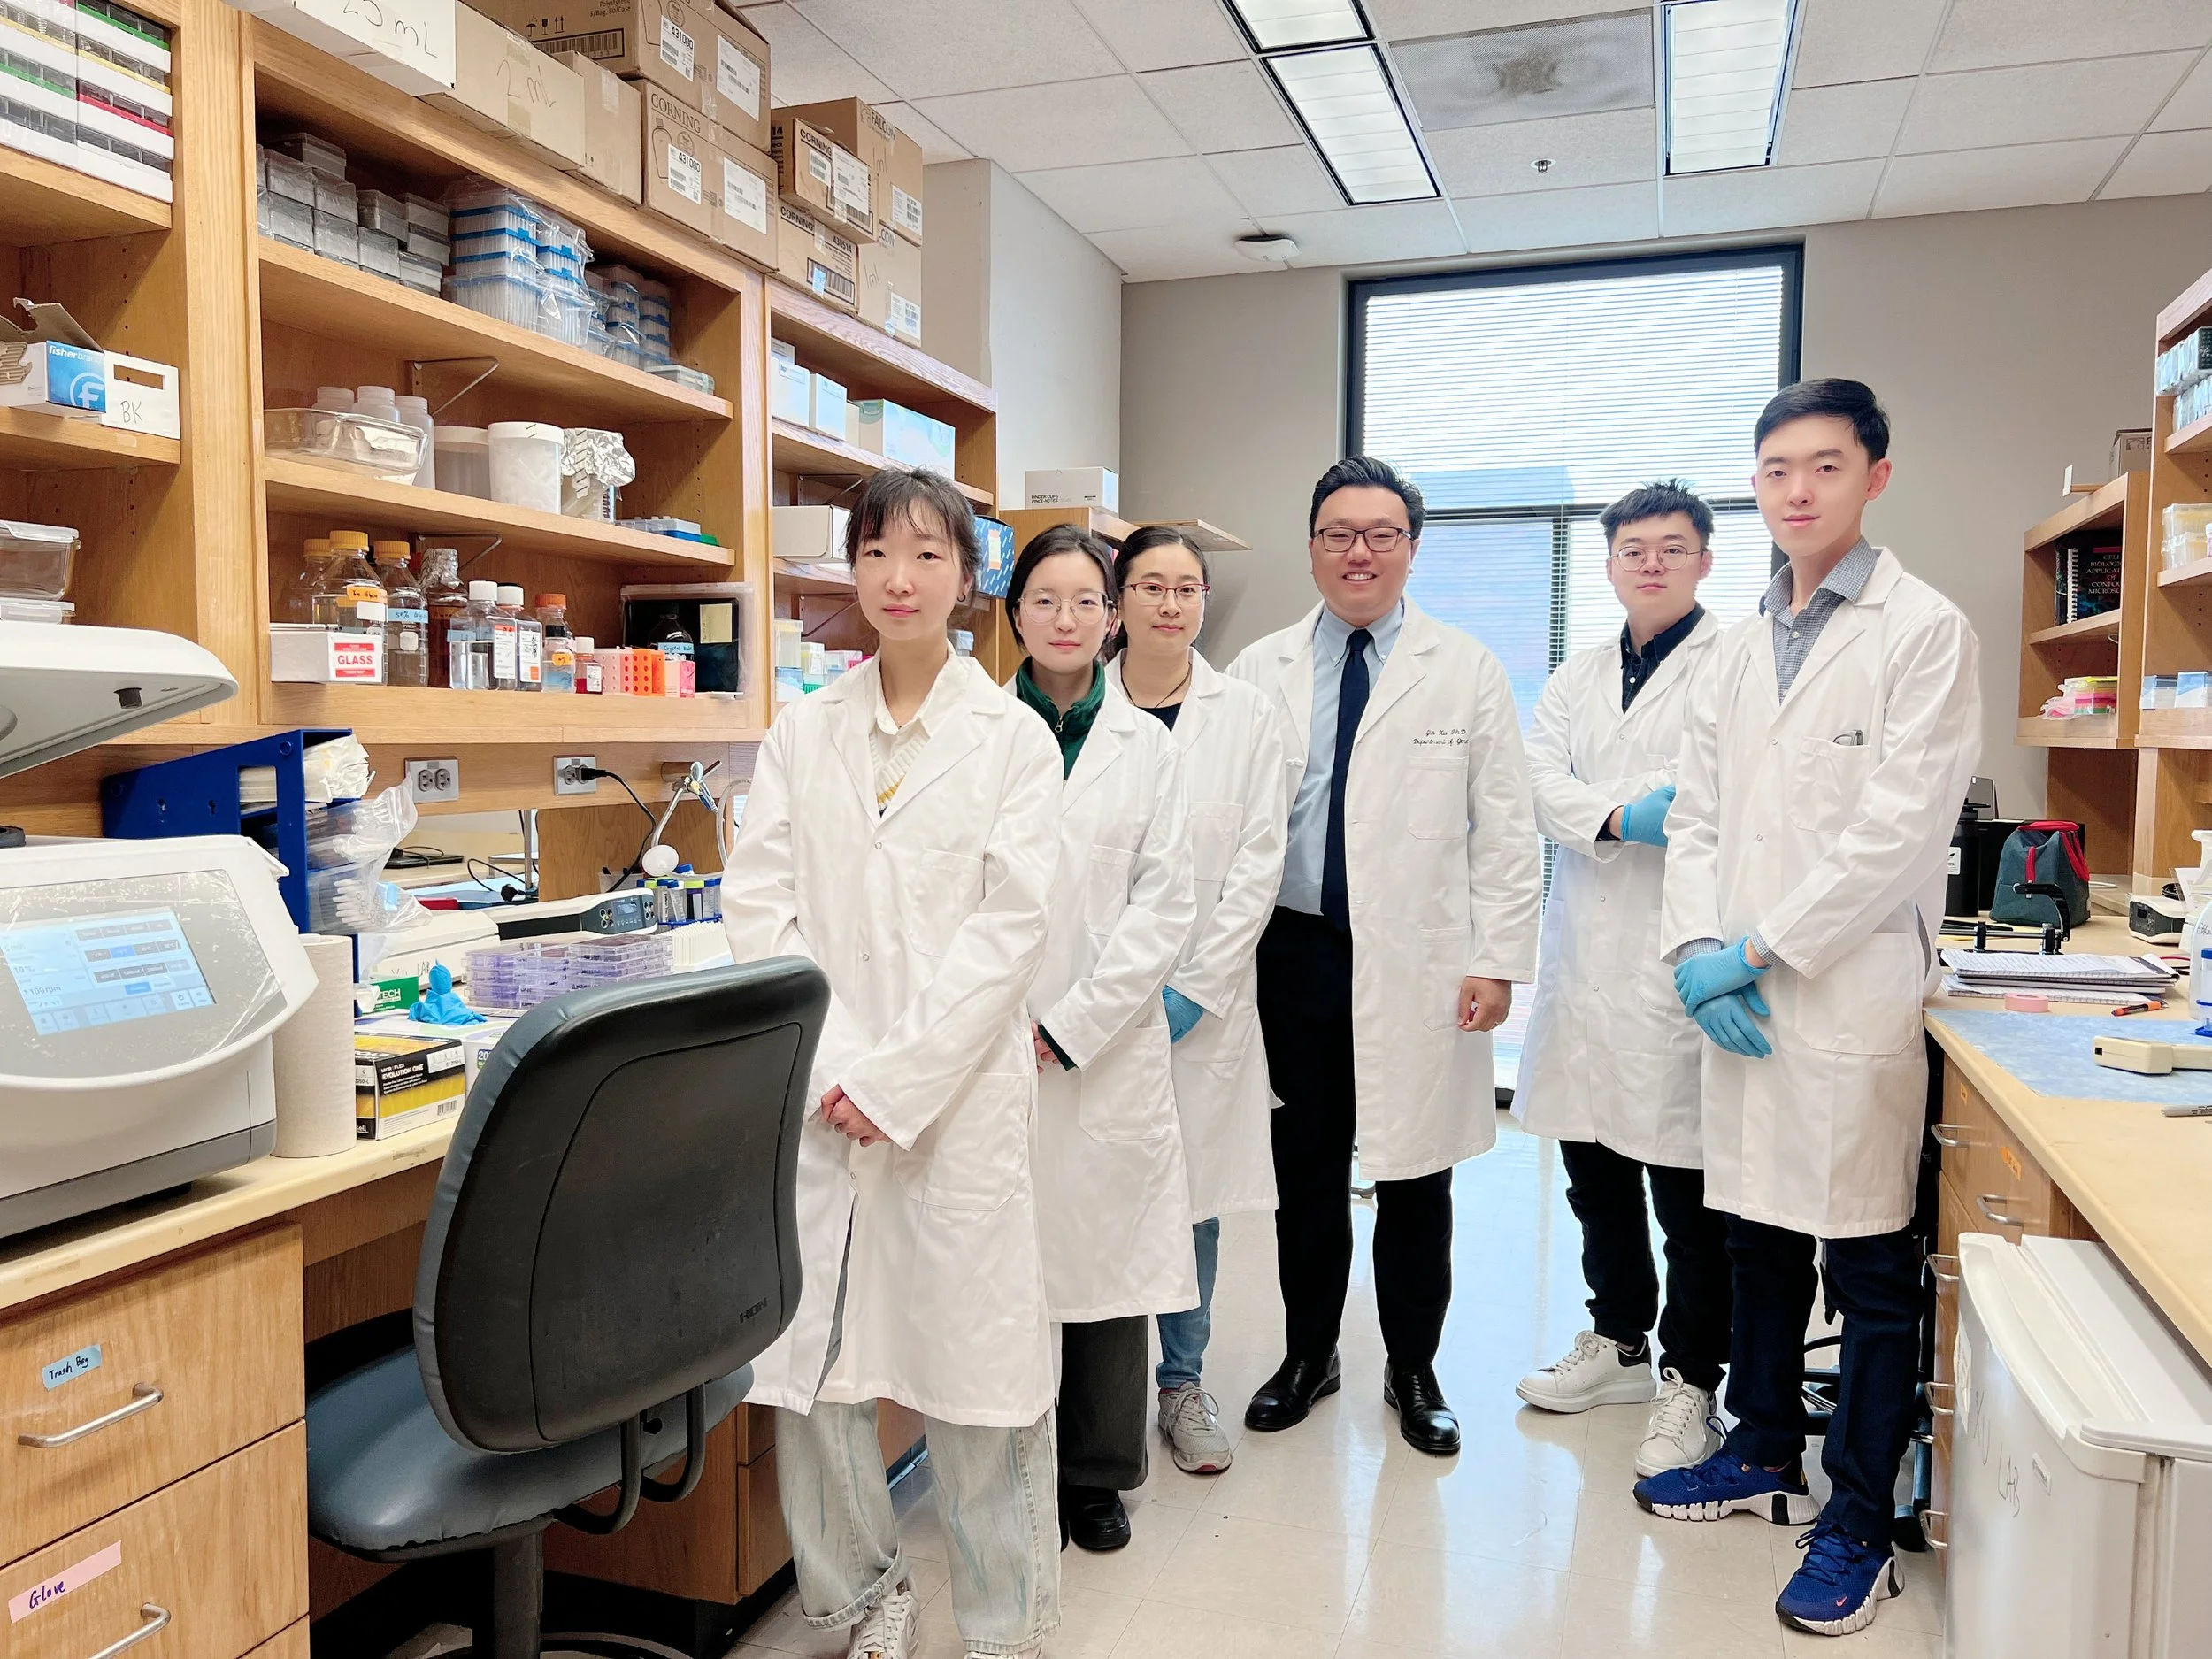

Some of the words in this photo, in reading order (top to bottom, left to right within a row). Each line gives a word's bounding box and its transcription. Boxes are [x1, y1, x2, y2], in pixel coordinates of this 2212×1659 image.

[671, 26, 694, 50] 431080
[651, 92, 701, 134] CORNING
[800, 128, 833, 156] CORNING
[678, 152, 701, 173] 431080
[780, 205, 814, 231] CORNING
[879, 227, 895, 248] LCON
[120, 400, 142, 425] BK
[337, 655, 373, 665] GLASS
[478, 1050, 490, 1060] 20
[382, 1067, 412, 1079] EVOLUTION
[412, 1064, 424, 1072] ONE
[49, 1361, 73, 1380] Trash
[29, 1580, 66, 1609] Glove
